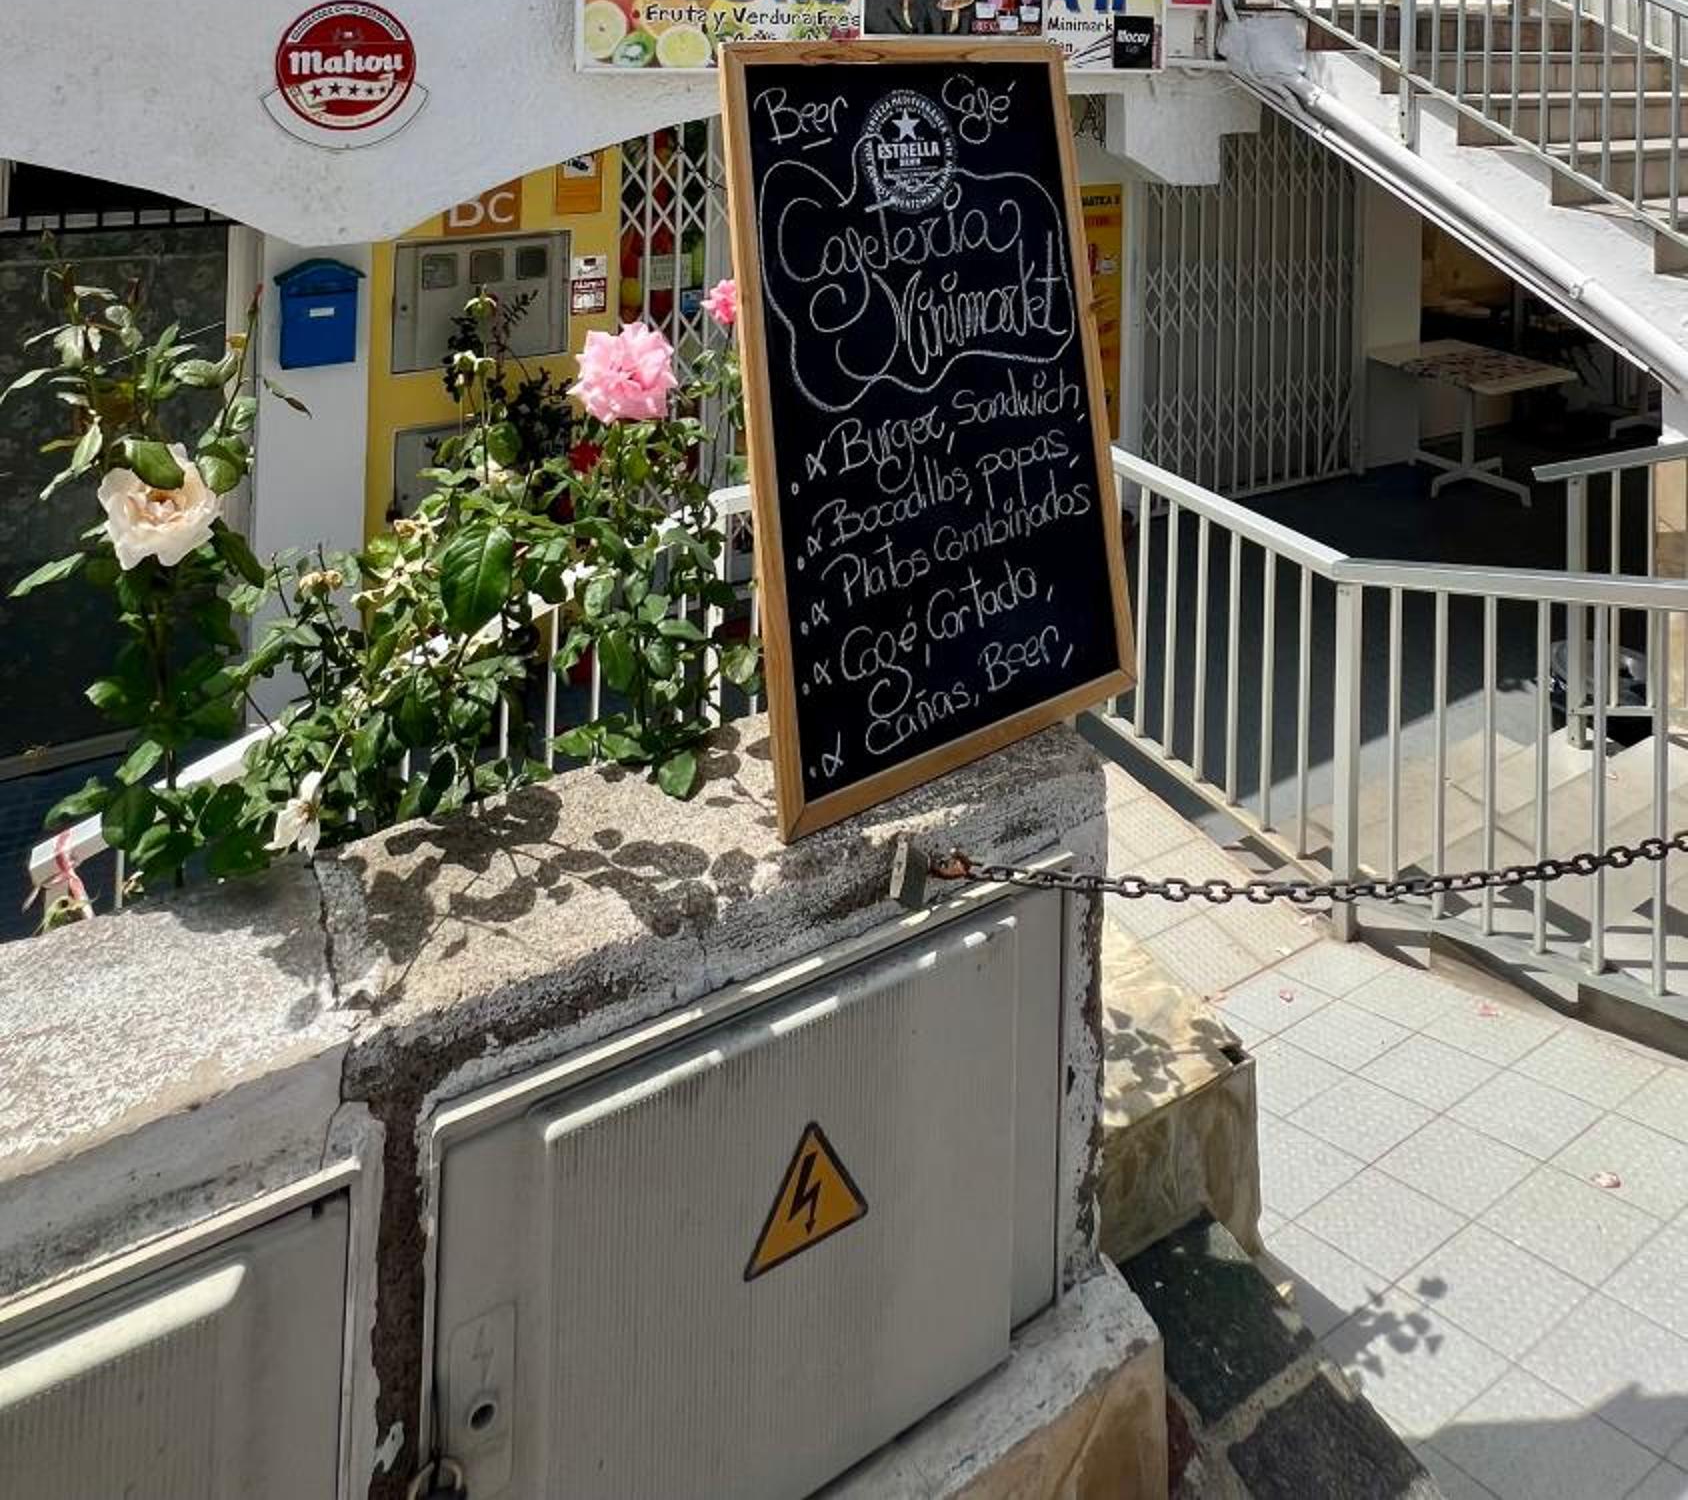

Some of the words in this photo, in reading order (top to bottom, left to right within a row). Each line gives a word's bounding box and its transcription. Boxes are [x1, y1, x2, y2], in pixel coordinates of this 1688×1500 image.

[646, 3, 707, 24] Fruta
[714, 10, 726, 32] y
[733, 7, 812, 26] Verdura
[817, 8, 861, 26] Fres
[1047, 17, 1113, 32] Minimark
[288, 49, 405, 75] Mahou
[754, 86, 848, 145] Beer
[941, 73, 1016, 145] Café
[877, 141, 941, 160] ESTRELLA
[820, 534, 931, 607] Platos
